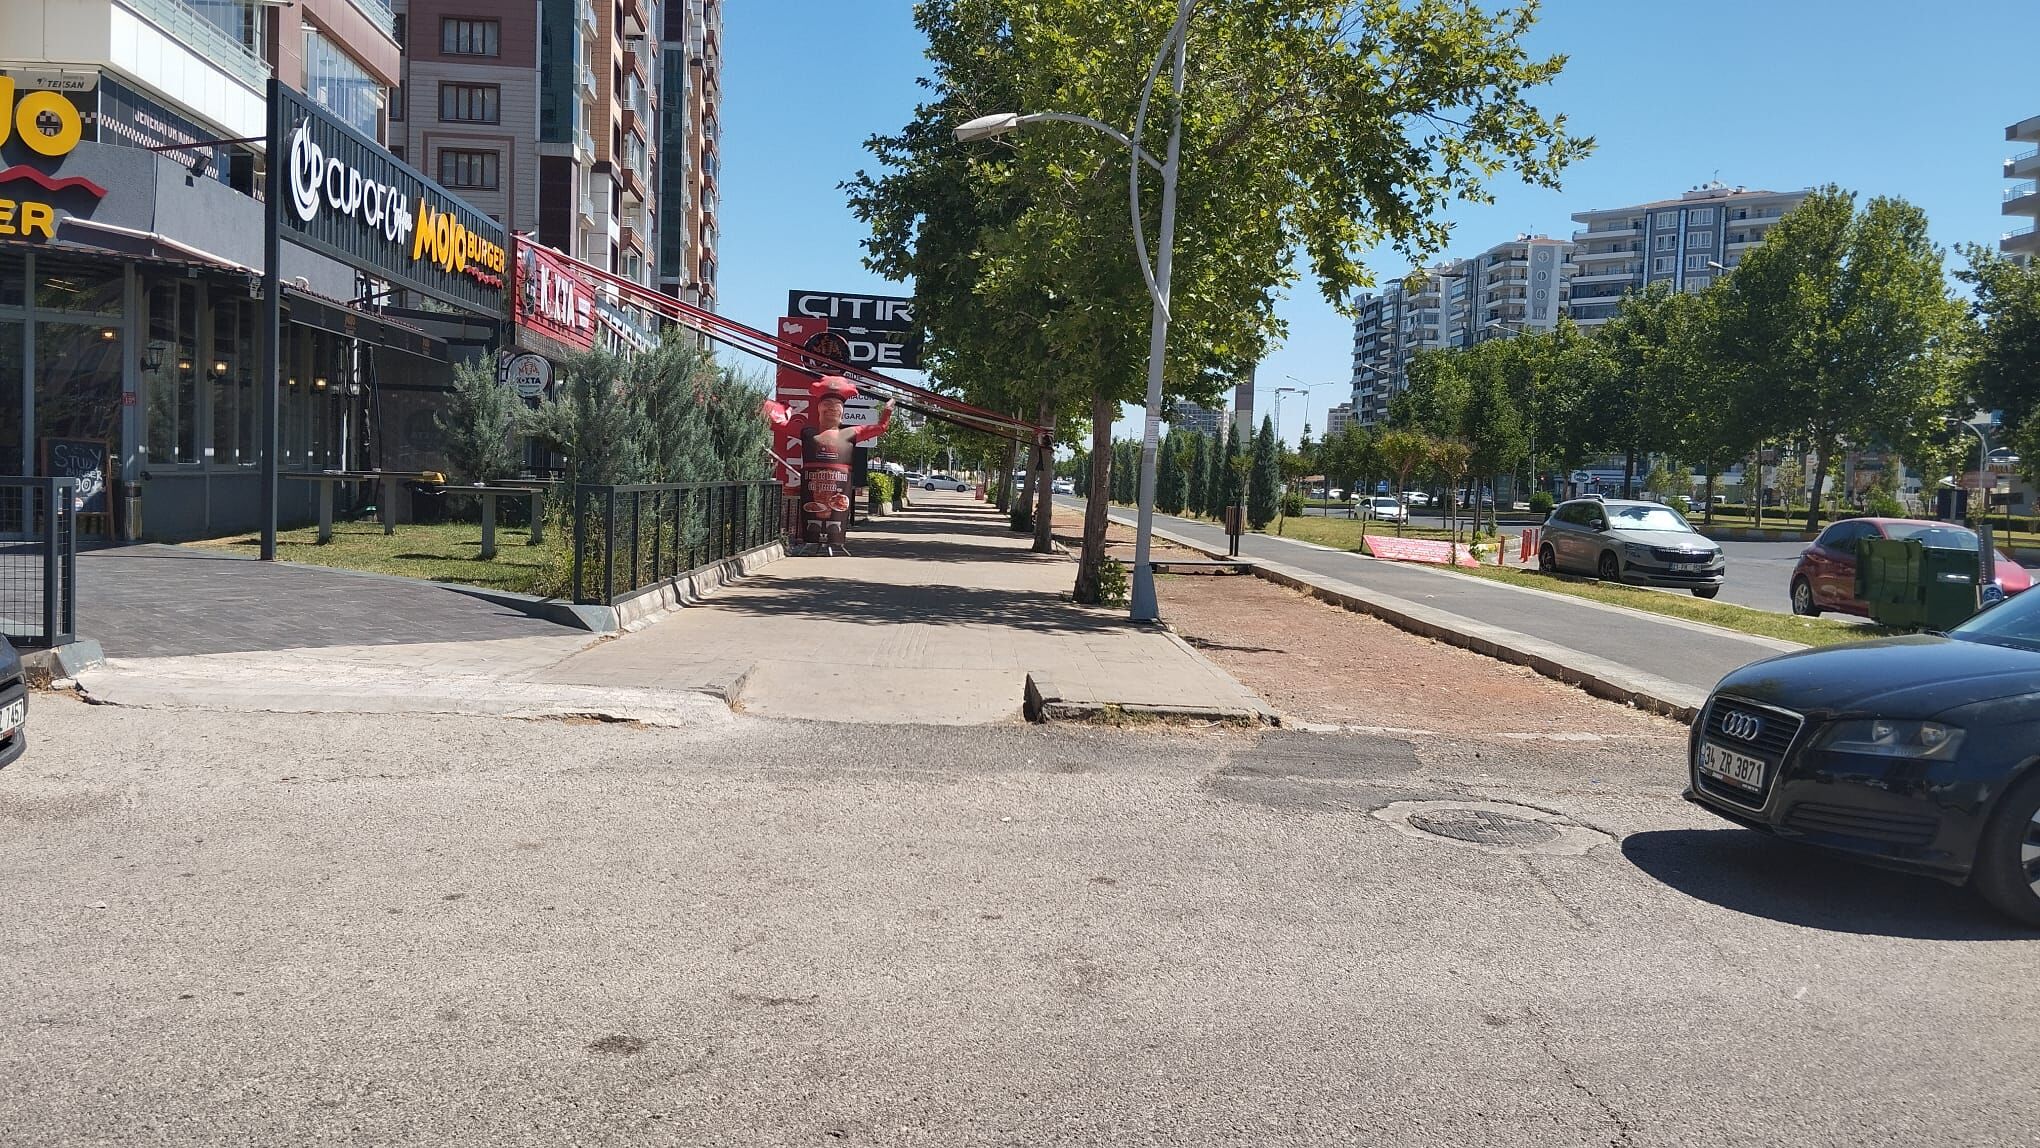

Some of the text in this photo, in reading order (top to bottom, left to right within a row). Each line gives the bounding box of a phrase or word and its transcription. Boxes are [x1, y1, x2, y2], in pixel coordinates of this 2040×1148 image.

[47, 80, 85, 89] TEKSAN
[327, 157, 362, 218] CUP
[363, 178, 386, 230] OF
[413, 196, 467, 273] MOJO
[466, 231, 505, 275] BURGER
[843, 413, 867, 421] GARA
[1704, 746, 1716, 767] 34
[1719, 751, 1732, 774] ZR
[1735, 756, 1762, 785] 3871
